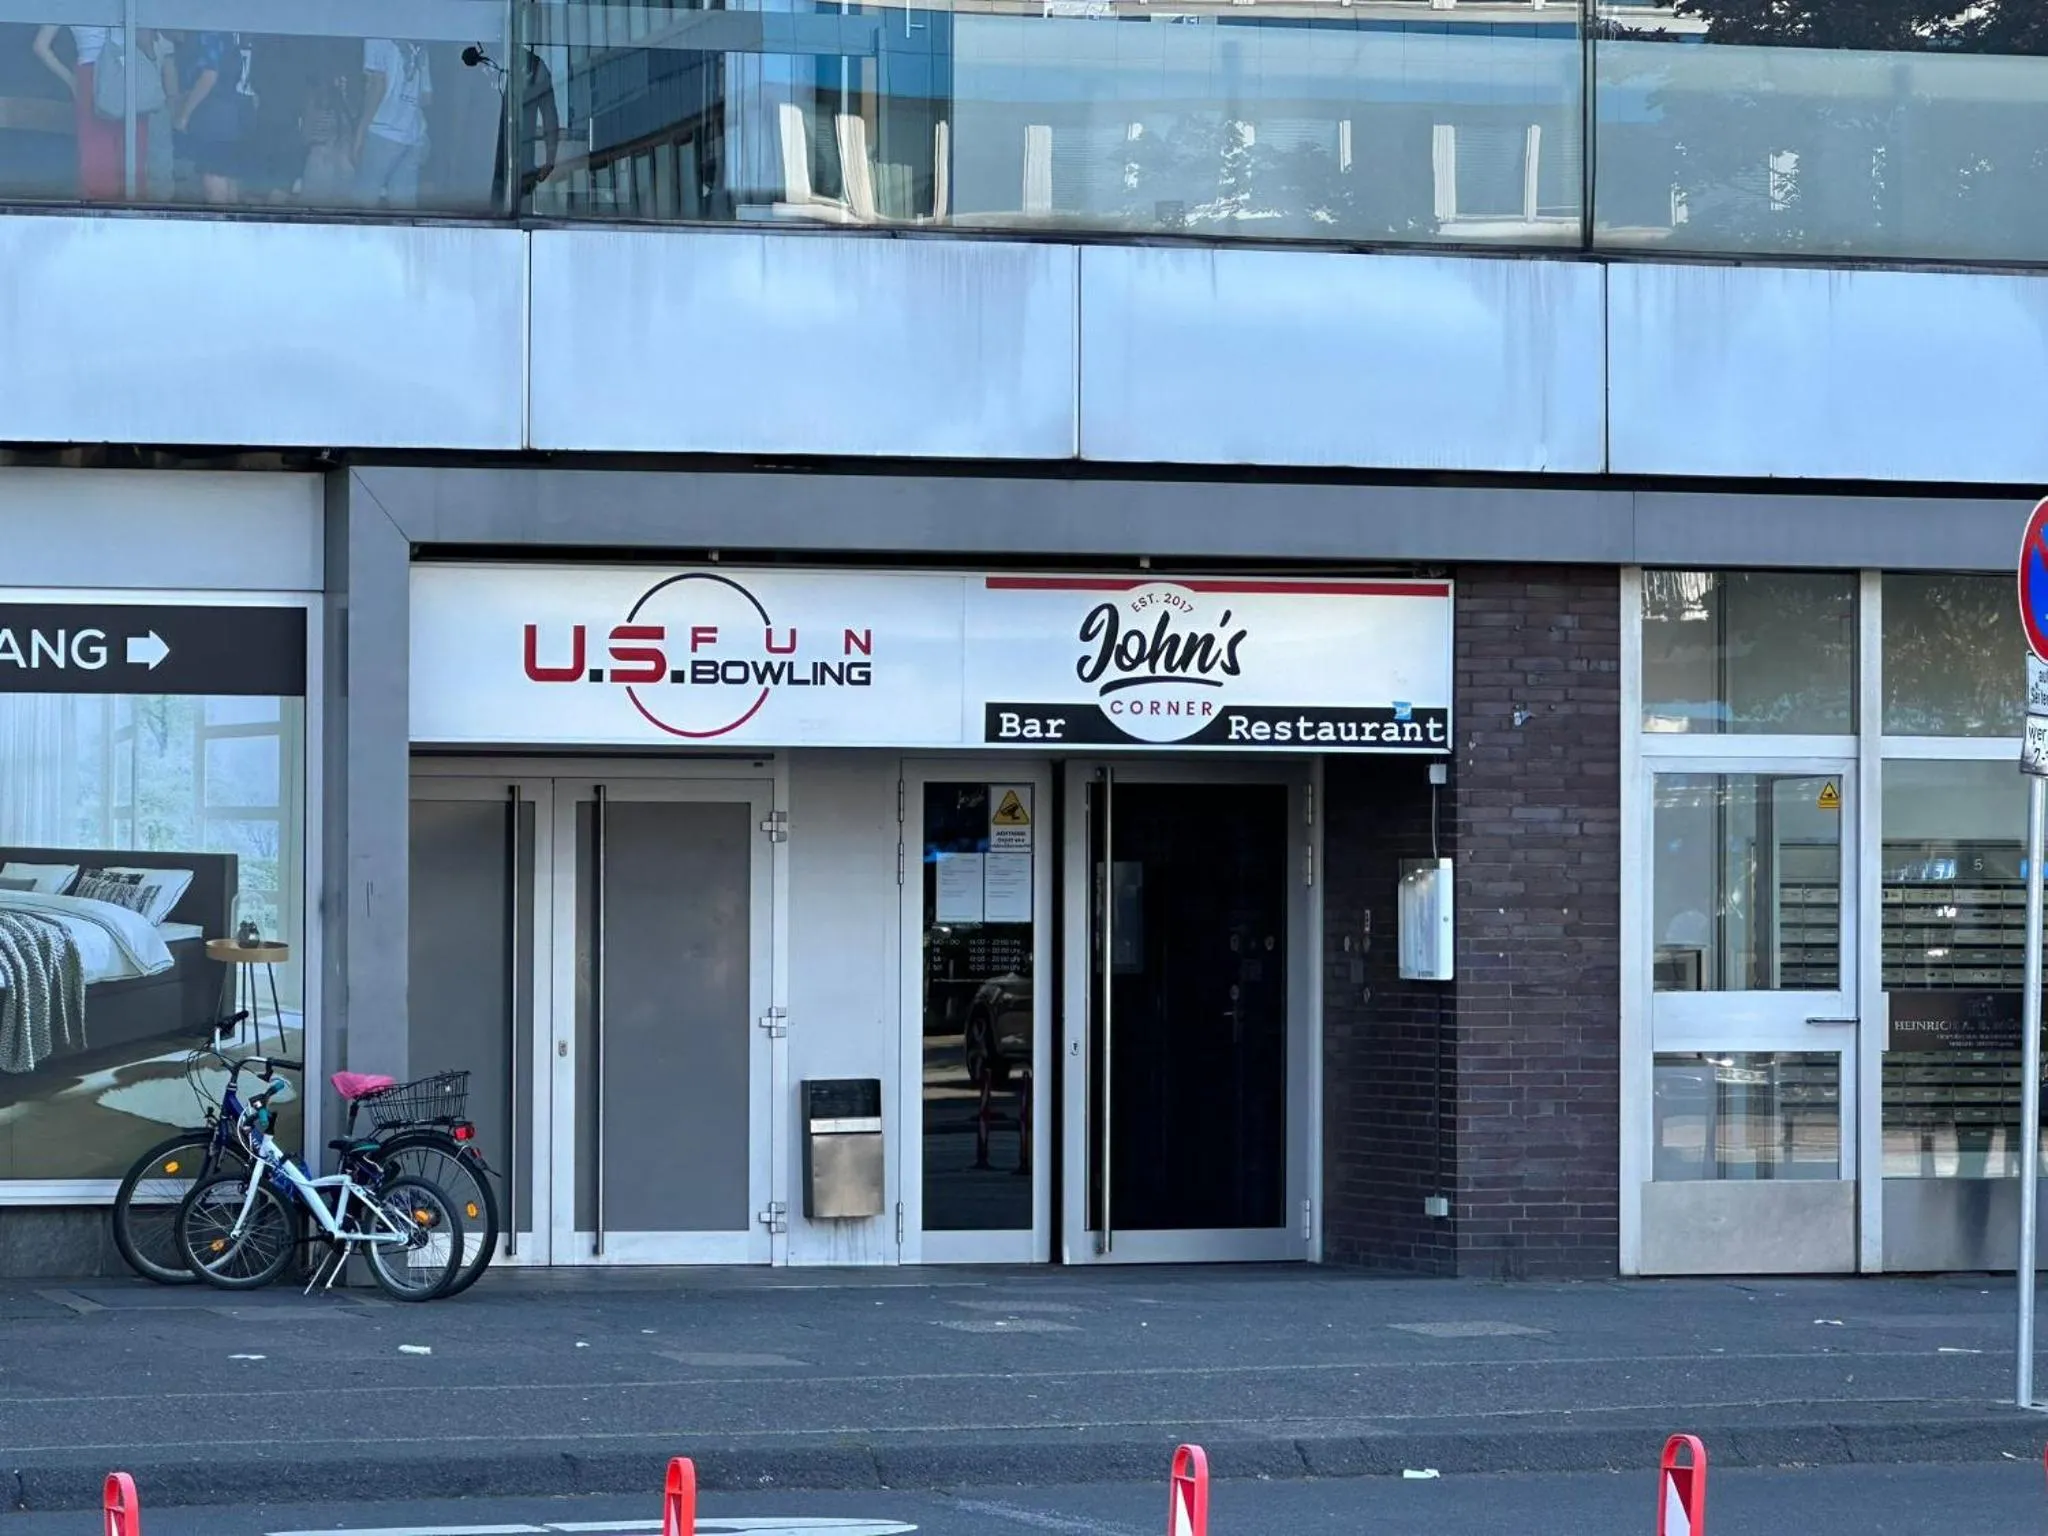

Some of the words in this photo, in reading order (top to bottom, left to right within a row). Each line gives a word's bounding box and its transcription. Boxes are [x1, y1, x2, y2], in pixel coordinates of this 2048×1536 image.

[1131, 593, 1159, 613] EST.
[1164, 592, 1194, 613] 2017
[0, 629, 108, 670] ANG
[524, 624, 685, 684] U.S.
[1076, 602, 1248, 683] John's
[690, 660, 872, 686] BOWLING
[1110, 699, 1214, 717] CORNER
[1000, 712, 1067, 740] Bar
[1227, 715, 1446, 743] Restaurant
